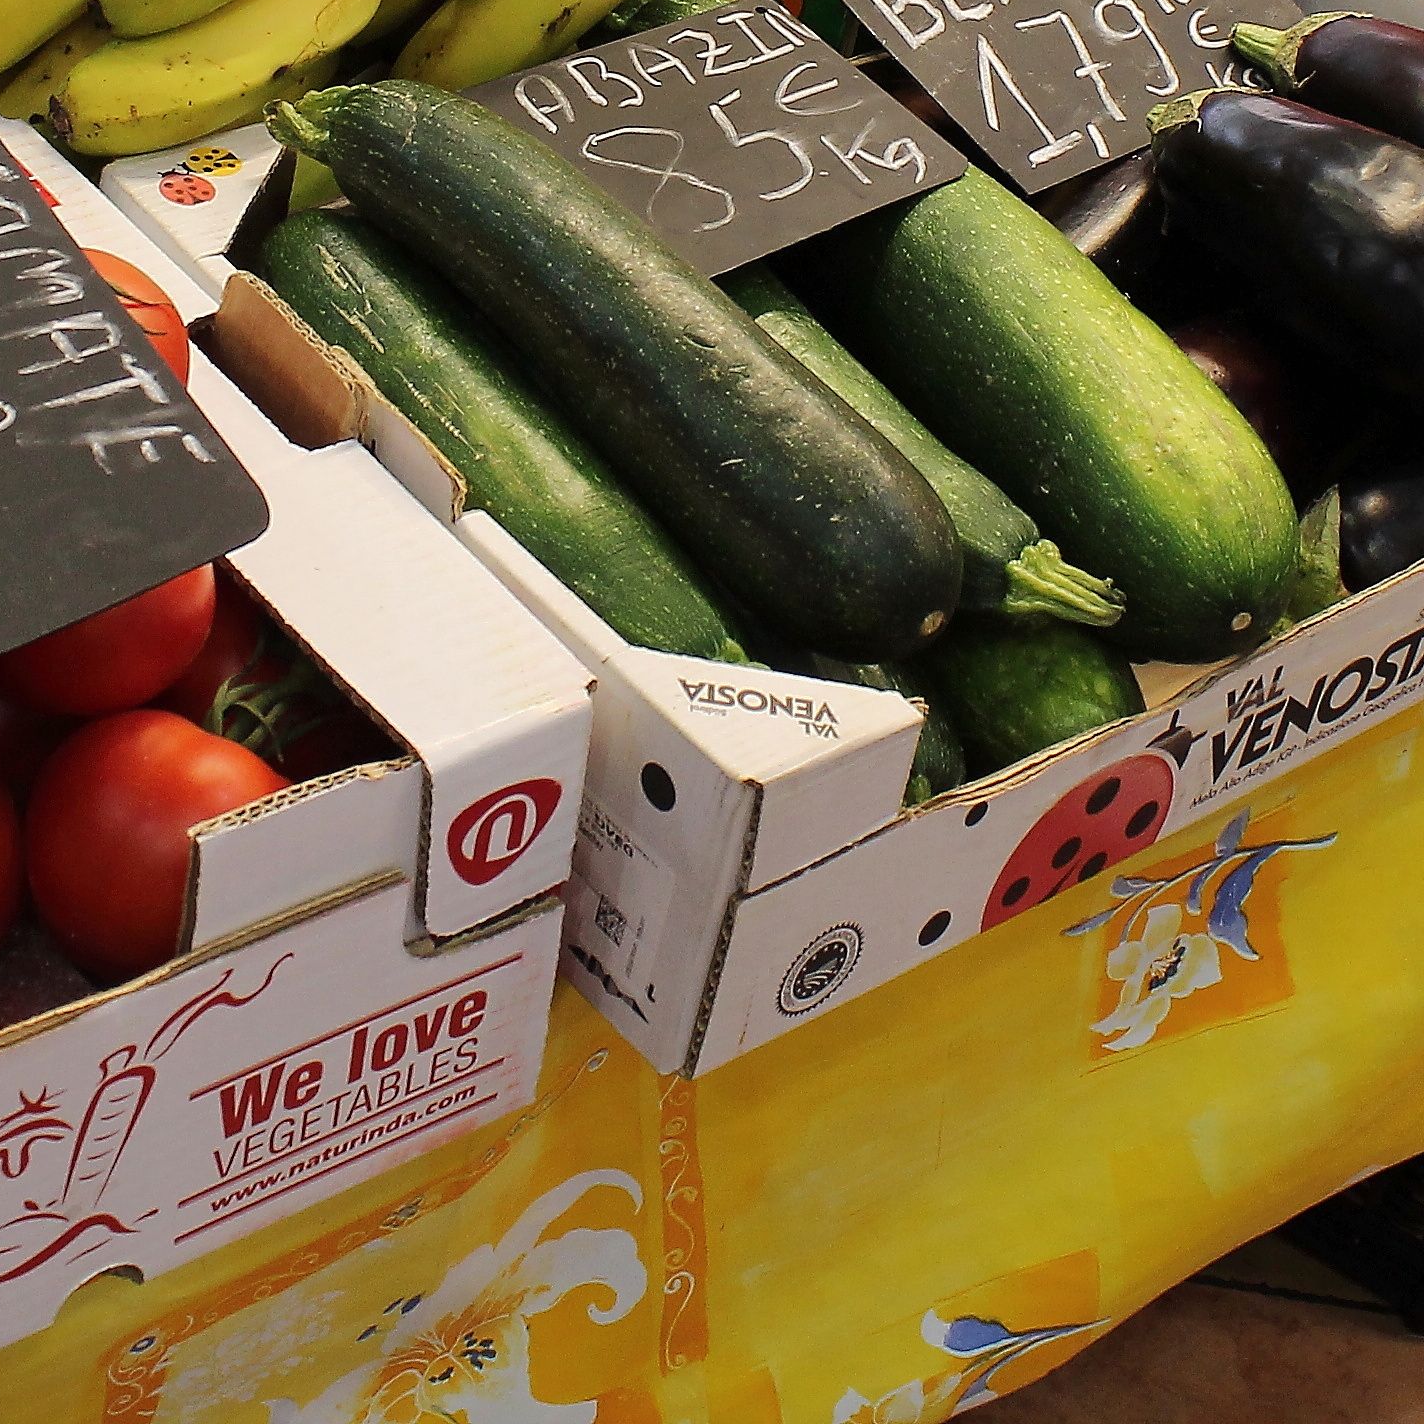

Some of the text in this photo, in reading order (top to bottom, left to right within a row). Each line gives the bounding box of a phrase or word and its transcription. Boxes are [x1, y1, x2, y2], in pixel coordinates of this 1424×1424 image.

[677, 677, 840, 725] VENOSTA
[798, 720, 841, 740] VAL
[1226, 664, 1285, 724] VAL
[211, 1036, 480, 1179] VEGETABLES
[219, 988, 490, 1139] We love
[210, 1084, 478, 1212] www.naturinda.com
